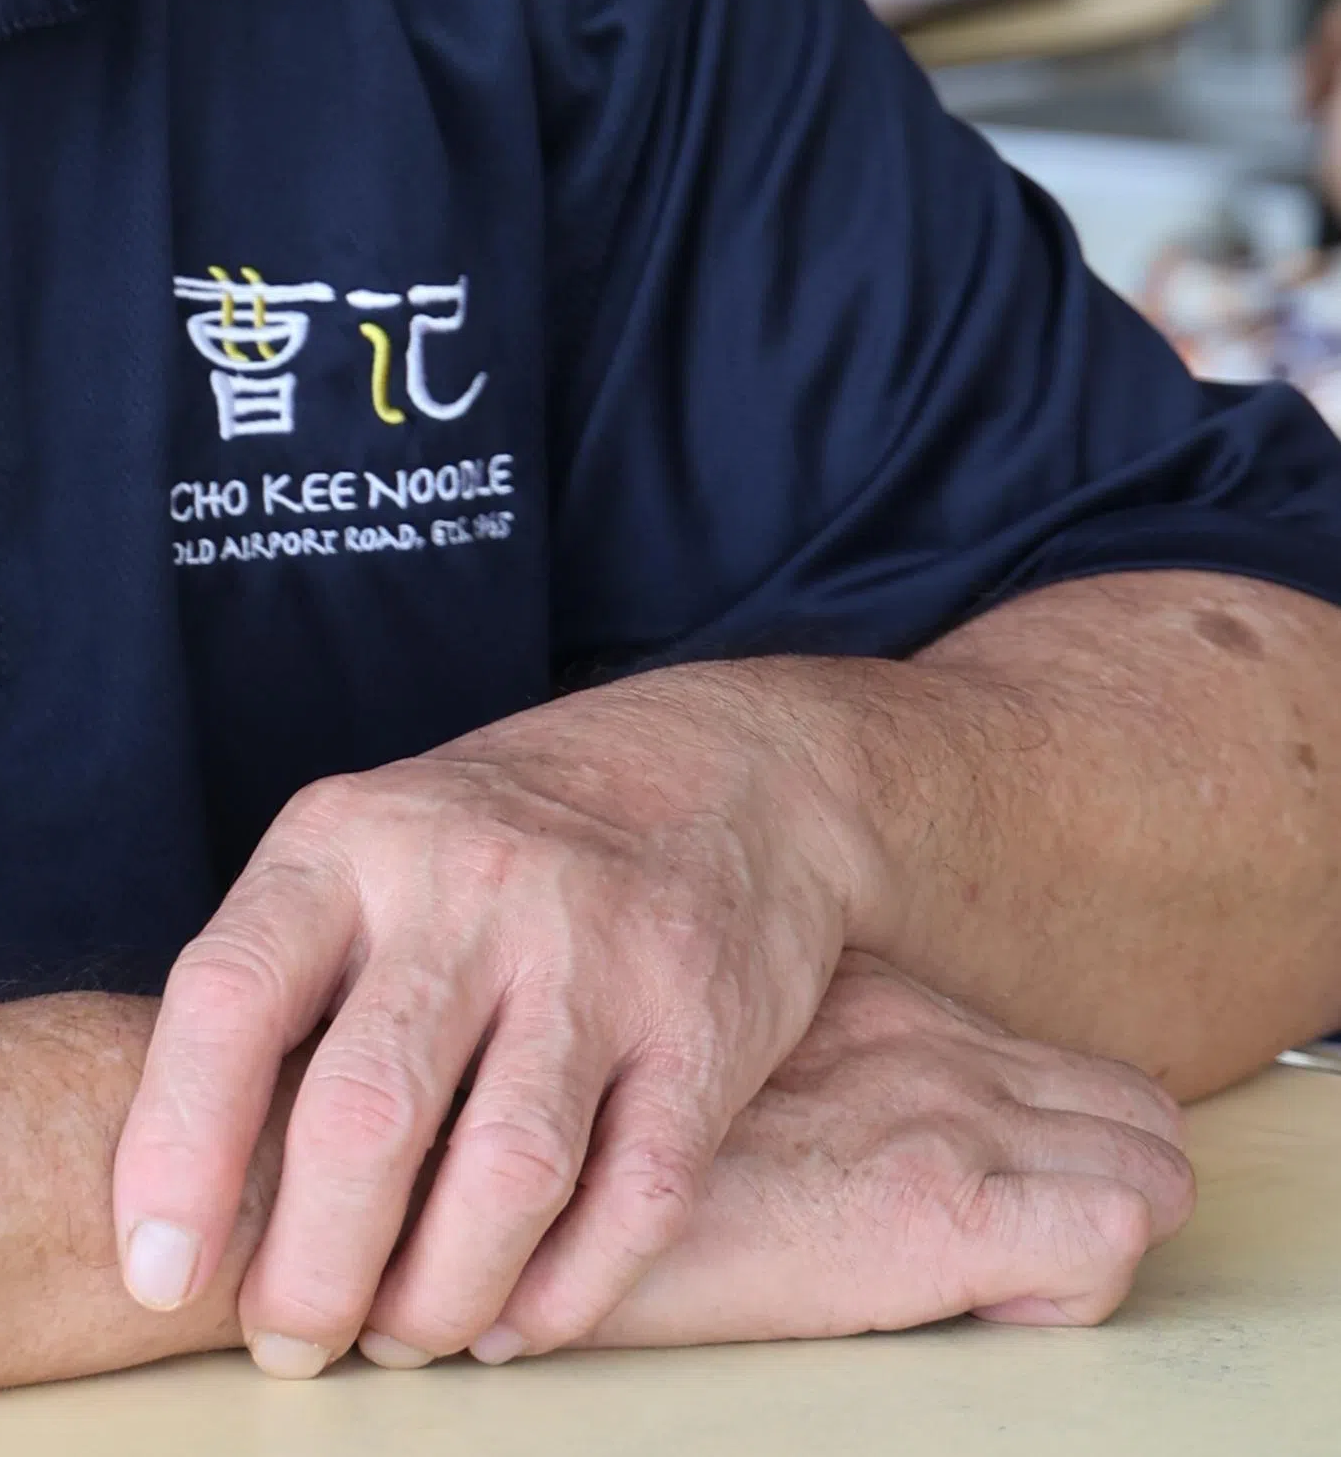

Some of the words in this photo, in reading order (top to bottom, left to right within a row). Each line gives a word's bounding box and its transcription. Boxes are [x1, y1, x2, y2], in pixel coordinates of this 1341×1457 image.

[170, 479, 250, 523] CHO
[261, 470, 359, 517] KEE
[363, 453, 515, 511] NOODLE
[220, 528, 340, 562] AIRPORT
